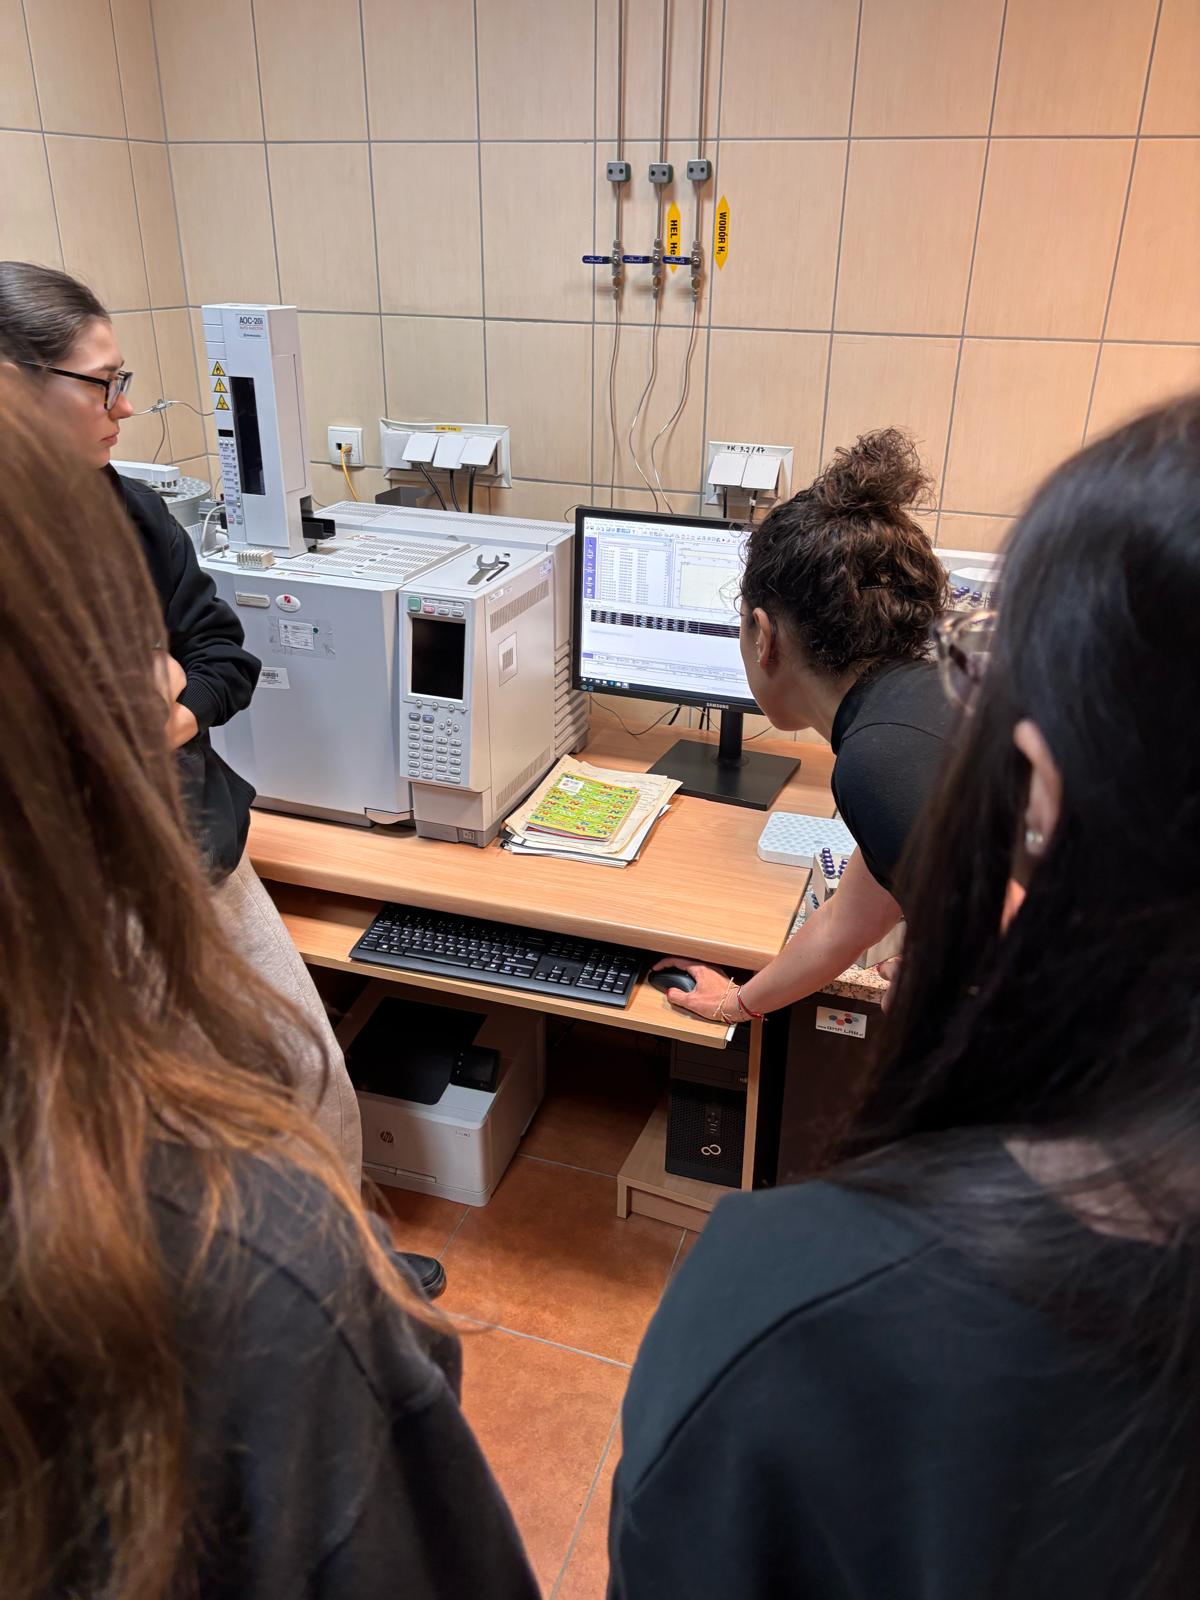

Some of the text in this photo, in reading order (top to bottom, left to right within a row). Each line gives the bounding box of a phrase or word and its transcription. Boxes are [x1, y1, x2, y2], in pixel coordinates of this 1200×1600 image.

[670, 219, 678, 239] HEL
[718, 212, 728, 244] WODÓR
[670, 242, 678, 255] He
